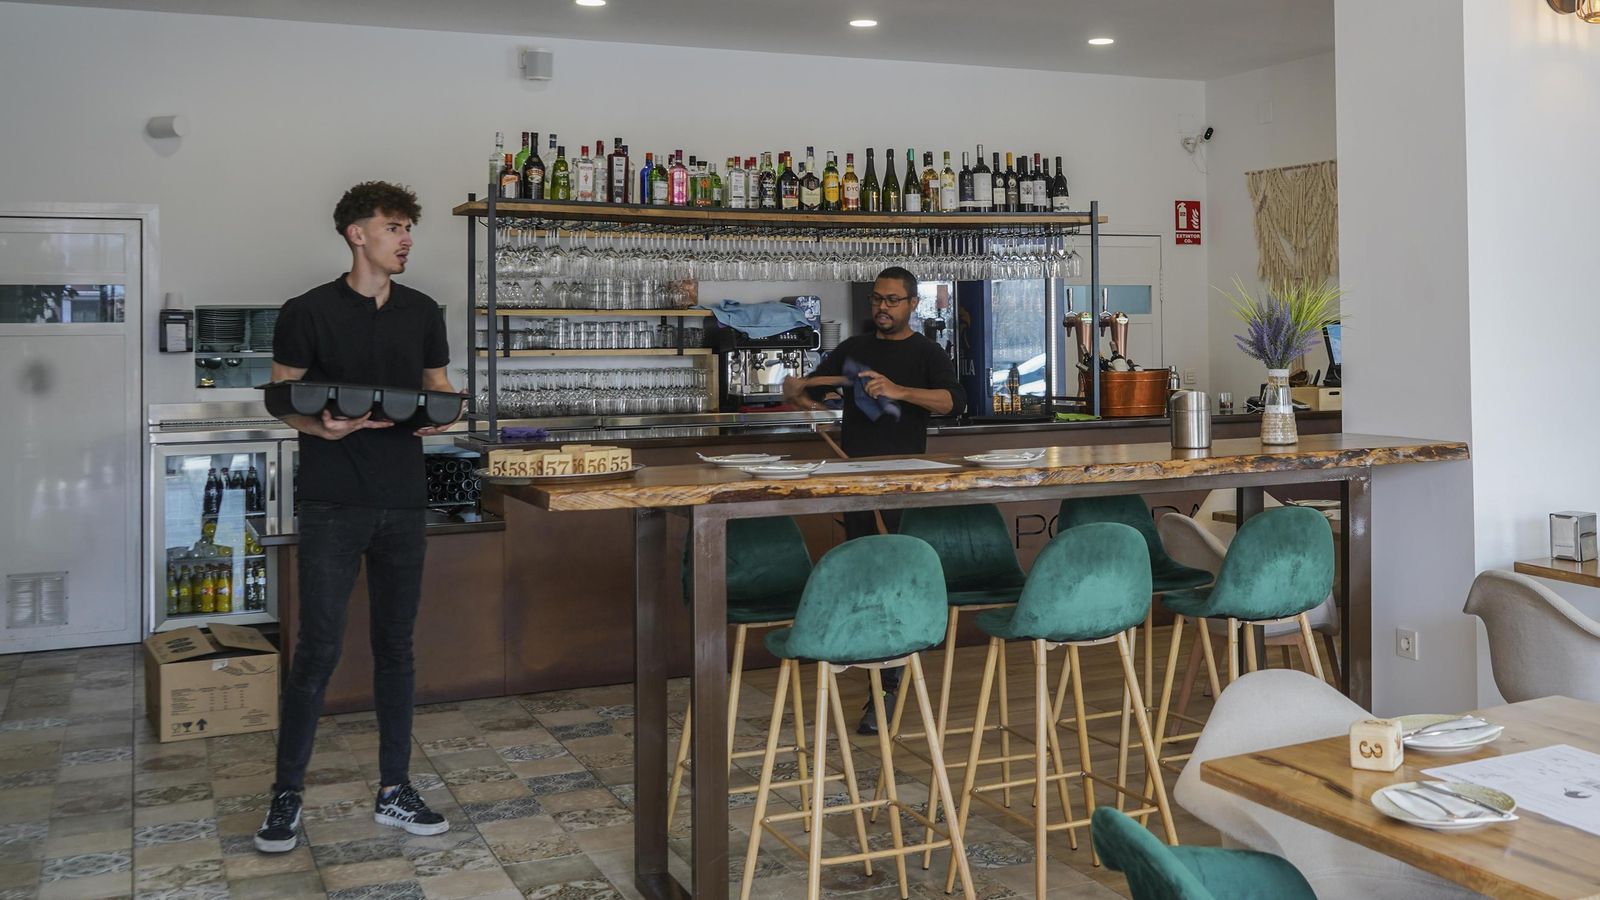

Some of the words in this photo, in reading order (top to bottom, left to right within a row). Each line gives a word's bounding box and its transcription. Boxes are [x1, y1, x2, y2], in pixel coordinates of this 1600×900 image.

[509, 461, 527, 476] 58
[545, 460, 570, 475] 57
[587, 457, 607, 473] 56
[610, 455, 630, 472] 55
[1359, 740, 1383, 759] 3
